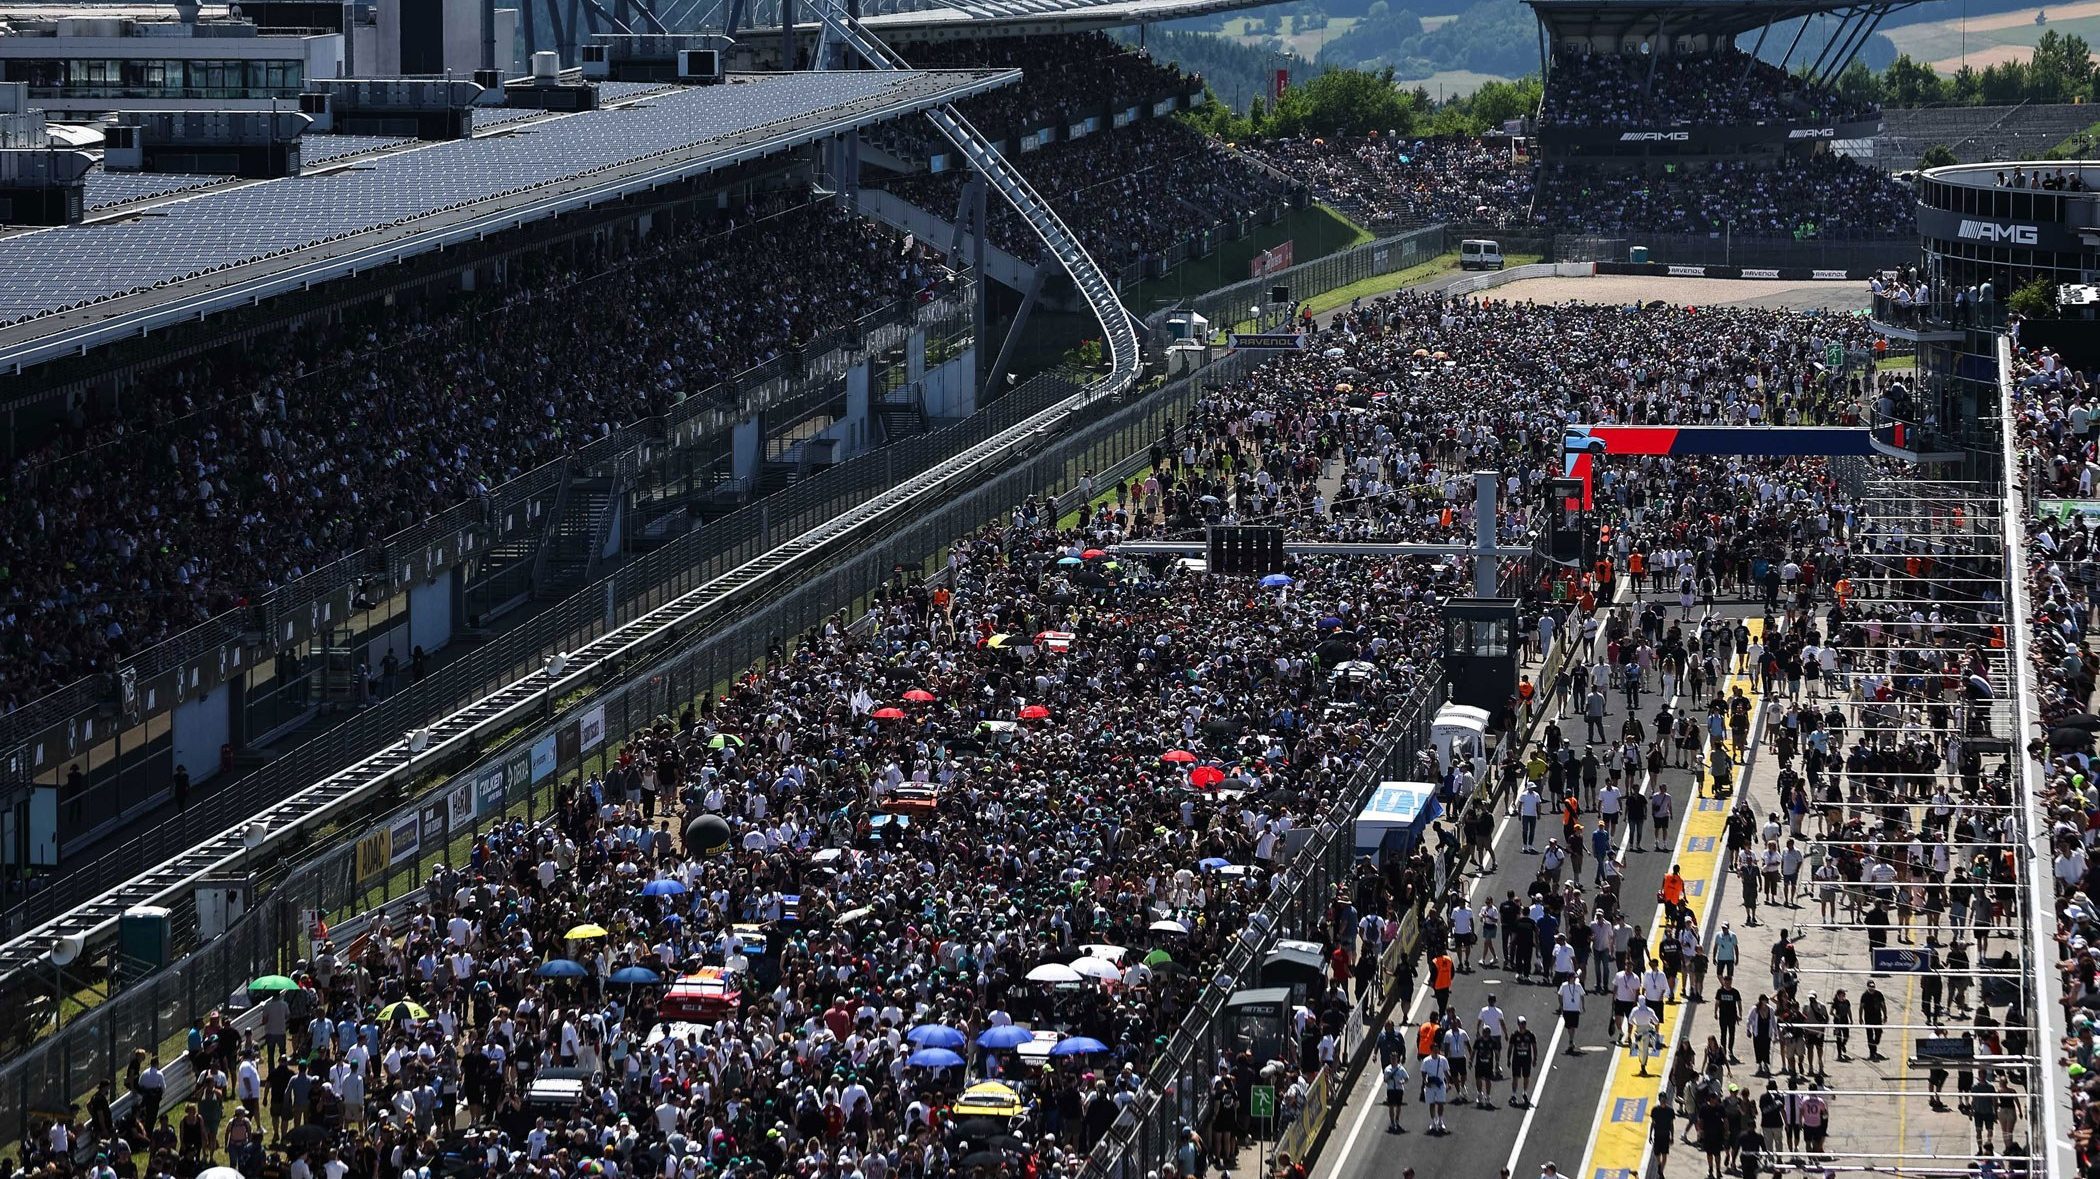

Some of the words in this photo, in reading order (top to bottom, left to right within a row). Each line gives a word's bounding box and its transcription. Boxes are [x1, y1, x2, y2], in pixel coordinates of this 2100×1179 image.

[1643, 132, 1689, 141] AMG
[1804, 128, 1834, 137] AMG
[1977, 222, 2038, 245] AMG
[1240, 338, 1294, 346] RAVENOL
[514, 759, 529, 786] DEKRA
[479, 771, 503, 798] FALKEN
[361, 832, 385, 878] ADAC
[1807, 1104, 1818, 1114] 10
